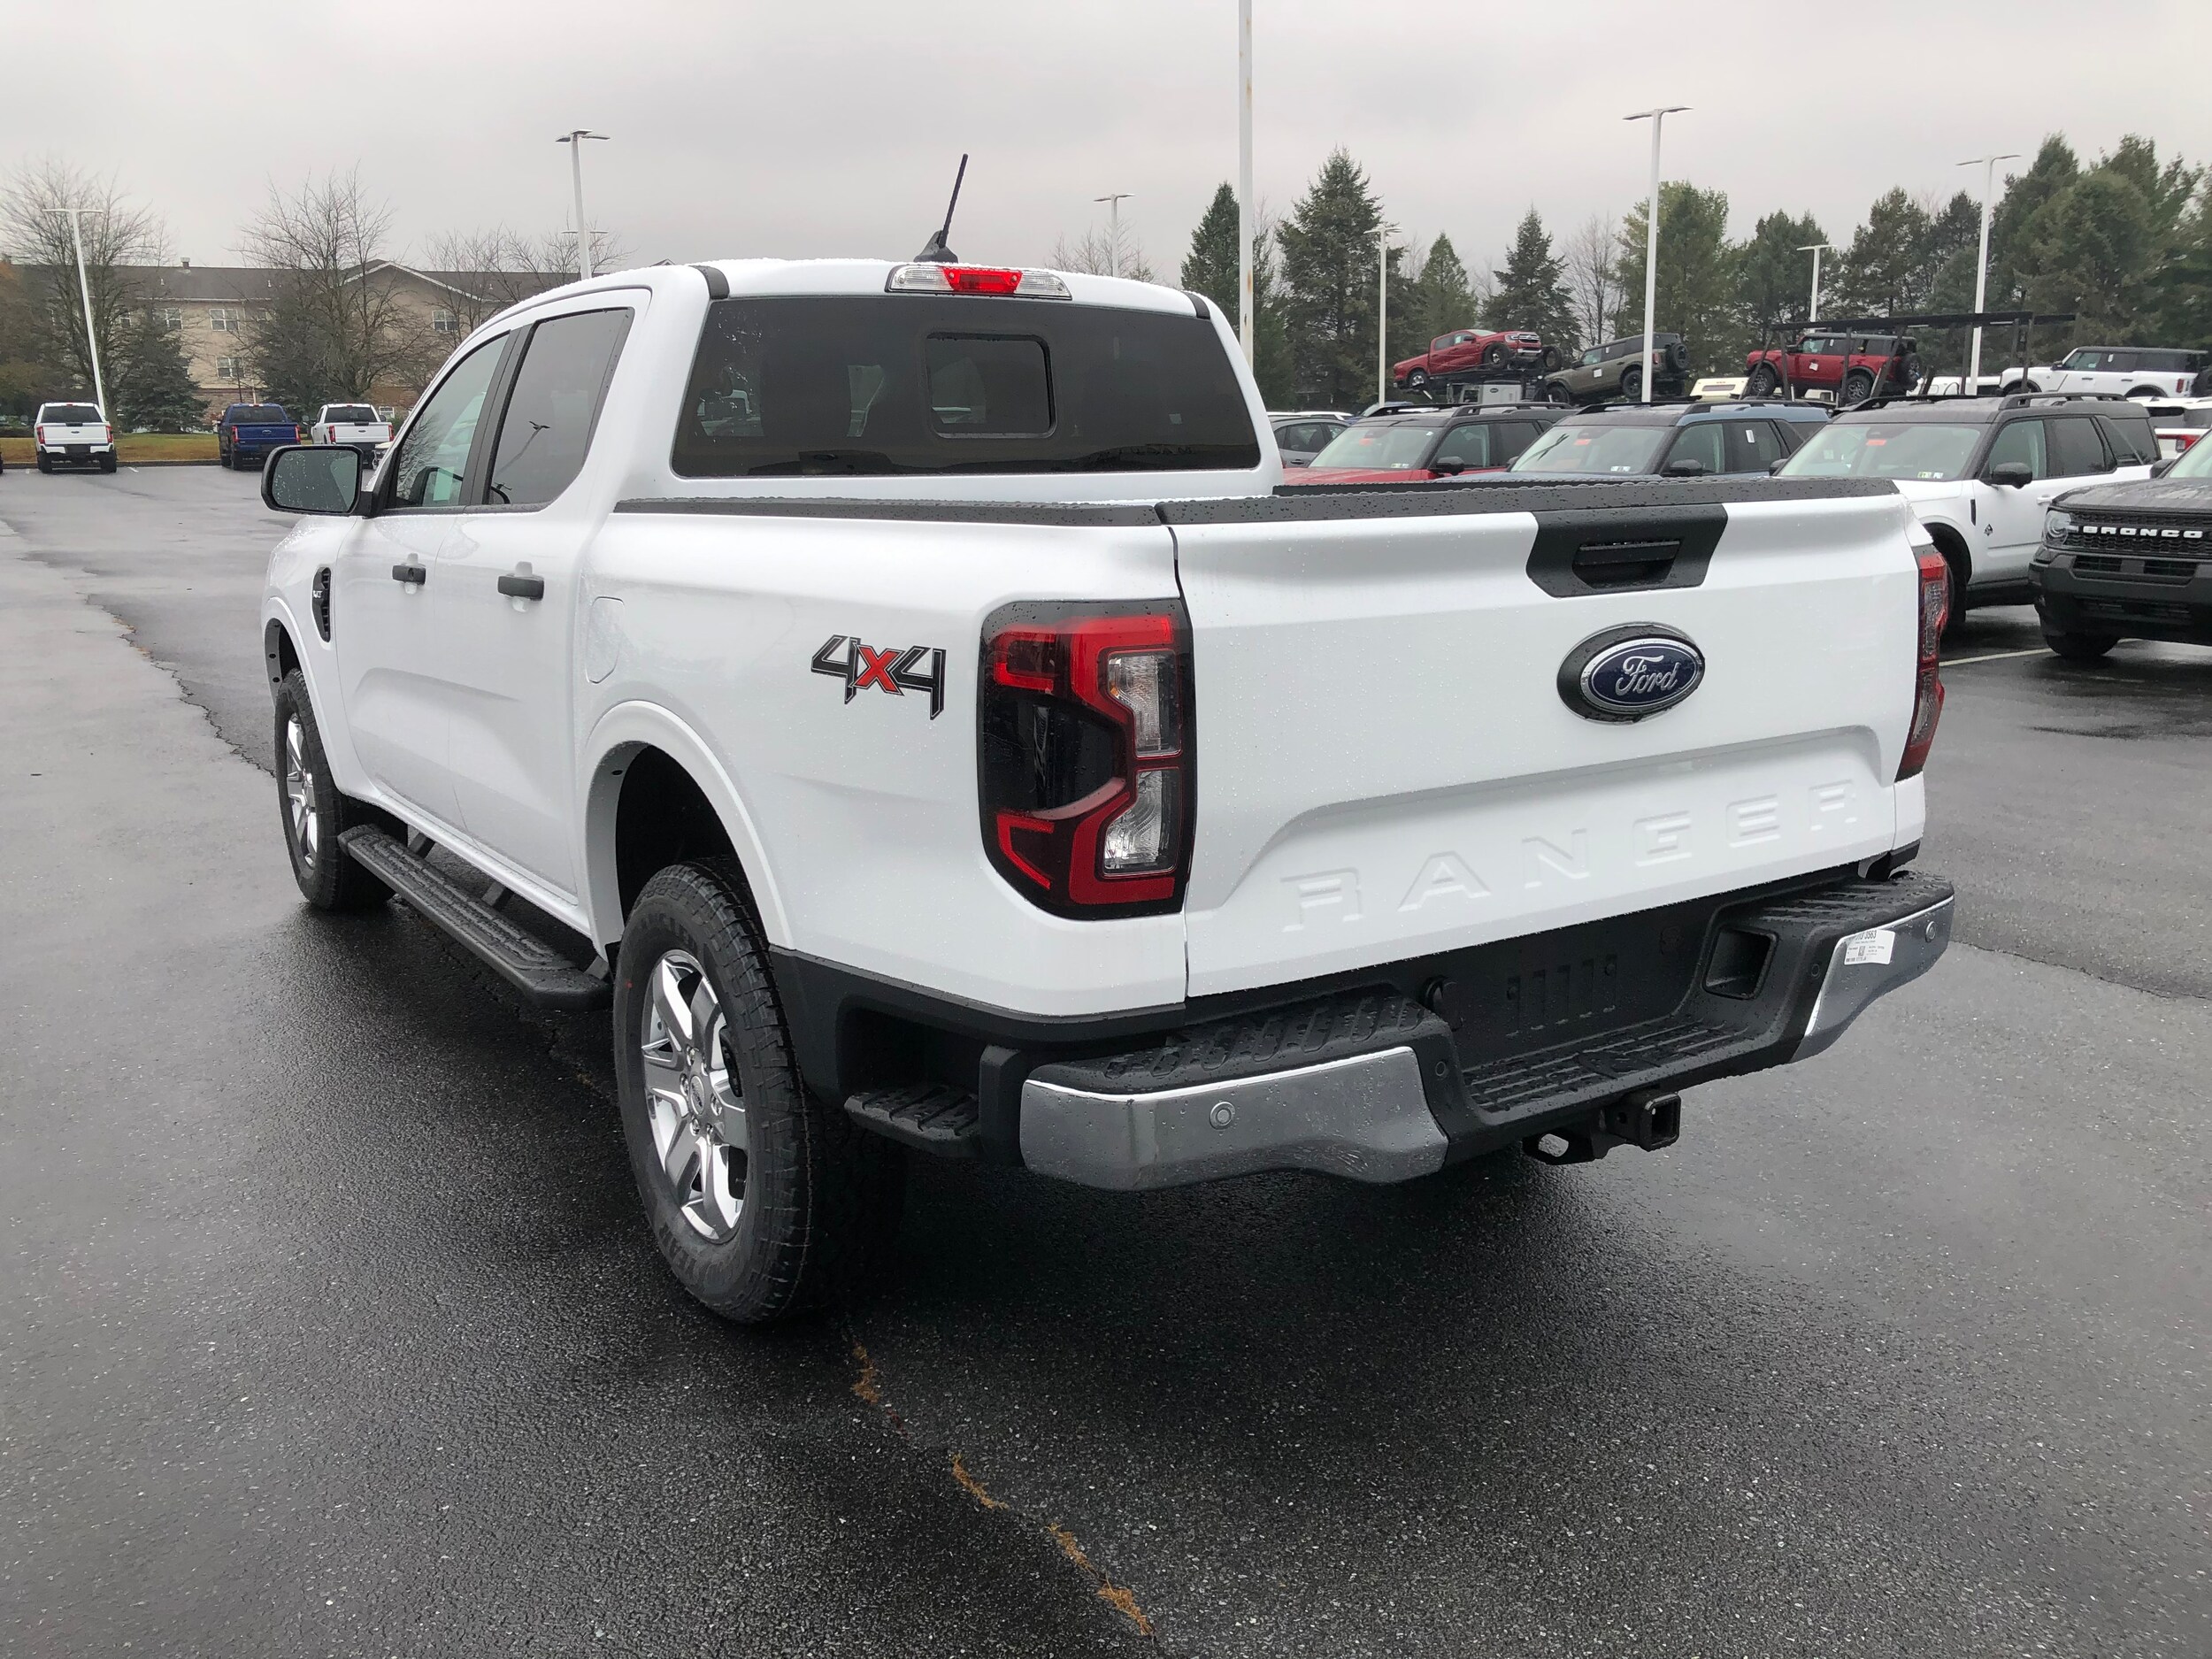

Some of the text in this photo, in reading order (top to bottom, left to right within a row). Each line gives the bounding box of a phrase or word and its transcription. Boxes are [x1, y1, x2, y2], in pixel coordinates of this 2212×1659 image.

[2083, 526, 2203, 539] BRONCO
[1616, 655, 1678, 695] Ford
[1282, 780, 1856, 932] RANGER
